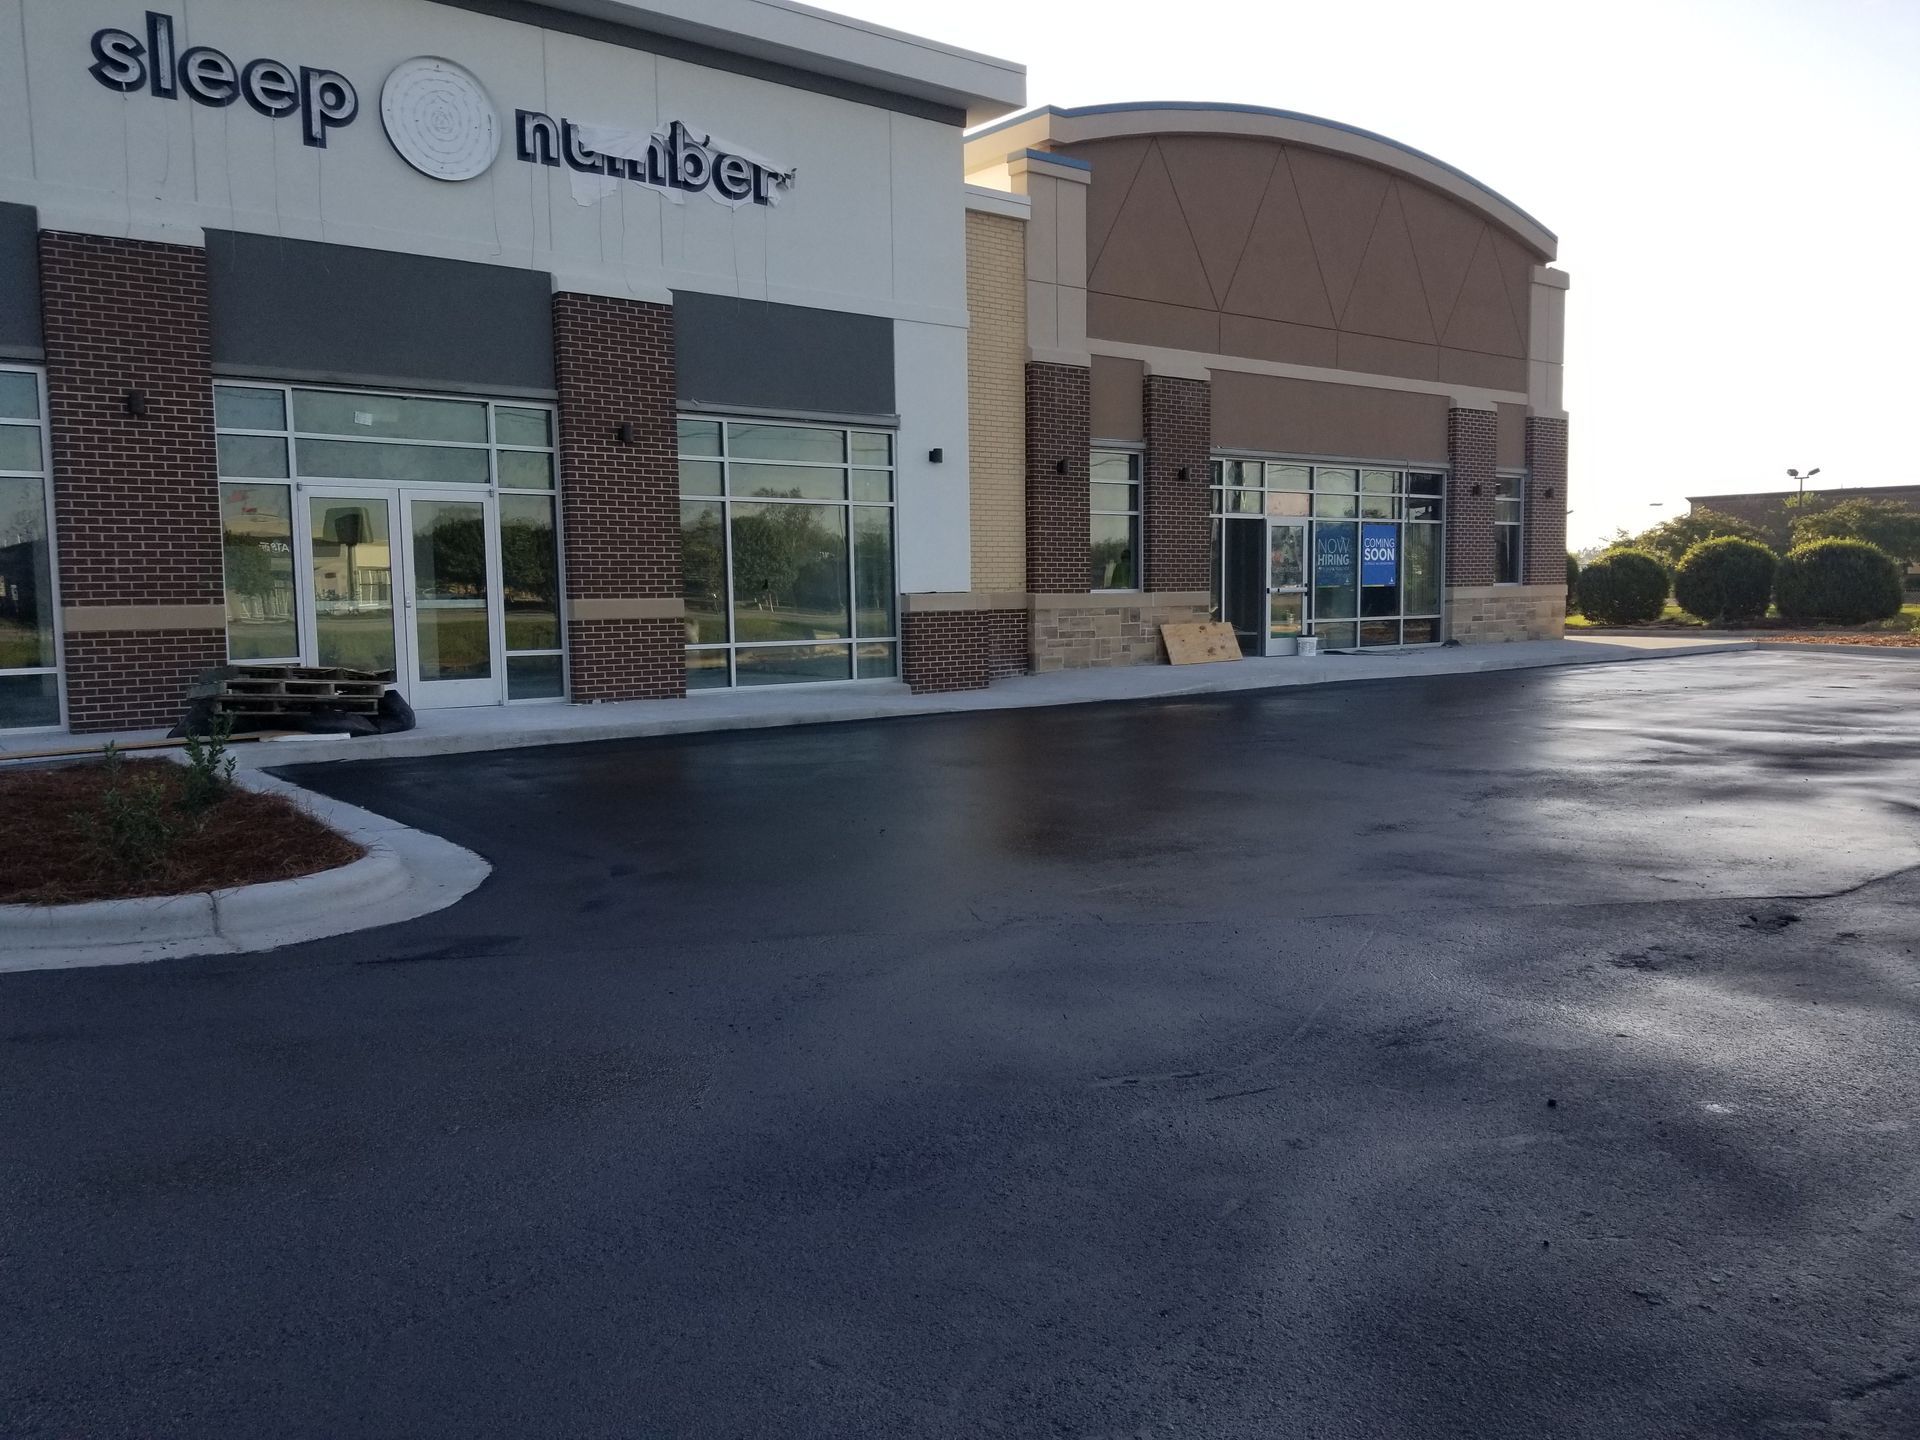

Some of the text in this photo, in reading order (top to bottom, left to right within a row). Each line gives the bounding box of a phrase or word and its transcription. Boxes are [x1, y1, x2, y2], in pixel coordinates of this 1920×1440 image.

[88, 10, 359, 149] sleep
[1318, 537, 1350, 554] NOW
[1364, 538, 1395, 548] COMING
[1317, 553, 1350, 566] HIRING
[1364, 547, 1395, 561] SOON
